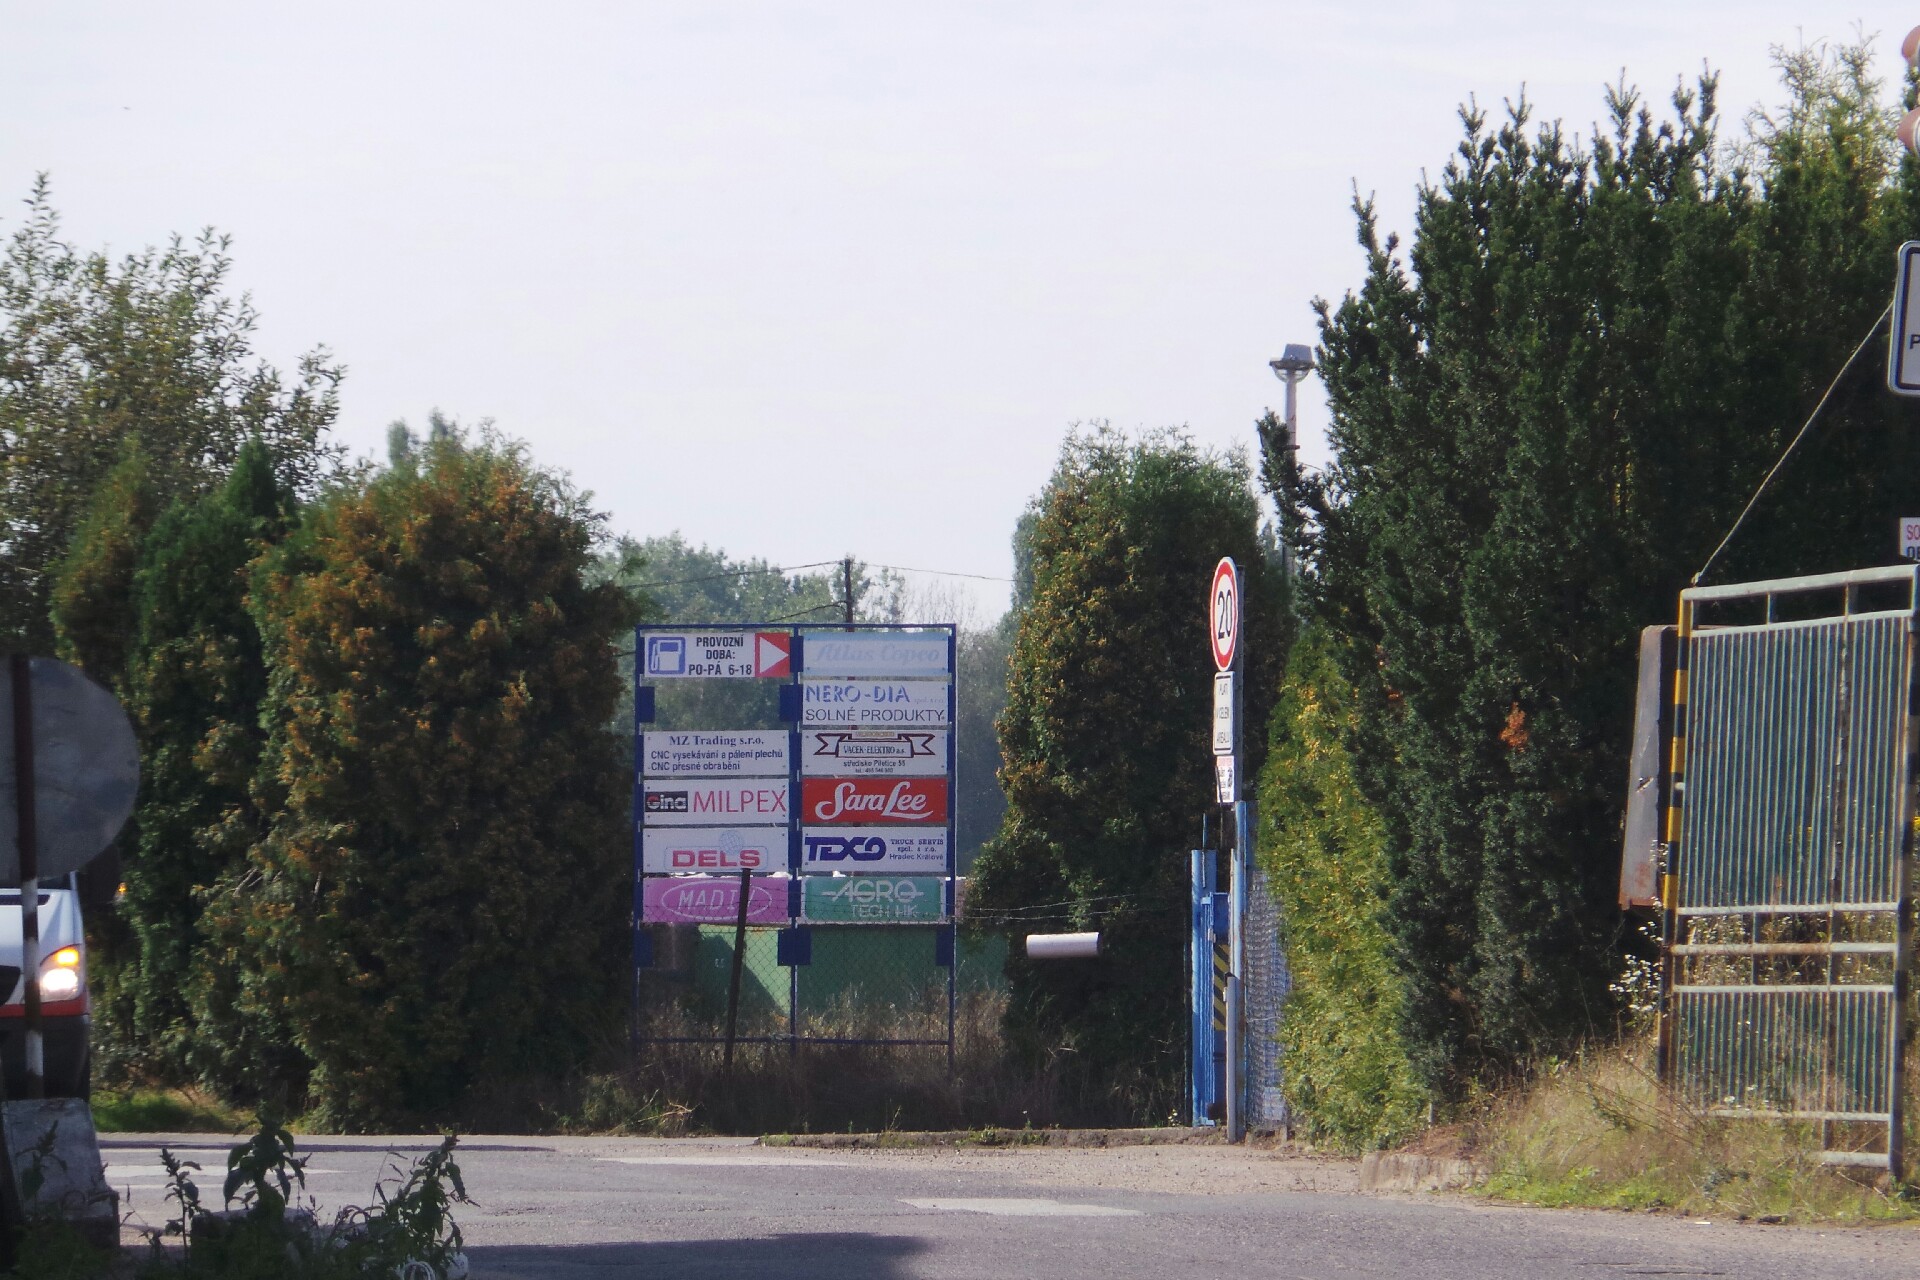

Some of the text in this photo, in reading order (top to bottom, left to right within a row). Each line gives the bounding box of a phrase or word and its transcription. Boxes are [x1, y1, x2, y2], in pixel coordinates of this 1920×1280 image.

[1217, 590, 1232, 640] 20
[696, 634, 744, 647] PROVOZNÍ
[706, 650, 736, 659] DOBA:
[688, 661, 752, 675] PO-PÁ 6-18
[805, 685, 910, 703] NERO-DIA
[805, 706, 944, 721] SOLNÉ PRODUKTY
[669, 735, 764, 747] MZ Trading s.r.o.
[651, 750, 670, 760] CNC
[672, 749, 719, 761] vysekávání
[728, 750, 753, 762] pálení
[755, 749, 783, 762] plechů
[651, 762, 670, 771] CNC
[672, 761, 701, 772] přesné
[693, 790, 787, 813] MILPEX
[804, 836, 887, 861] TEXO
[672, 849, 760, 867] DELS
